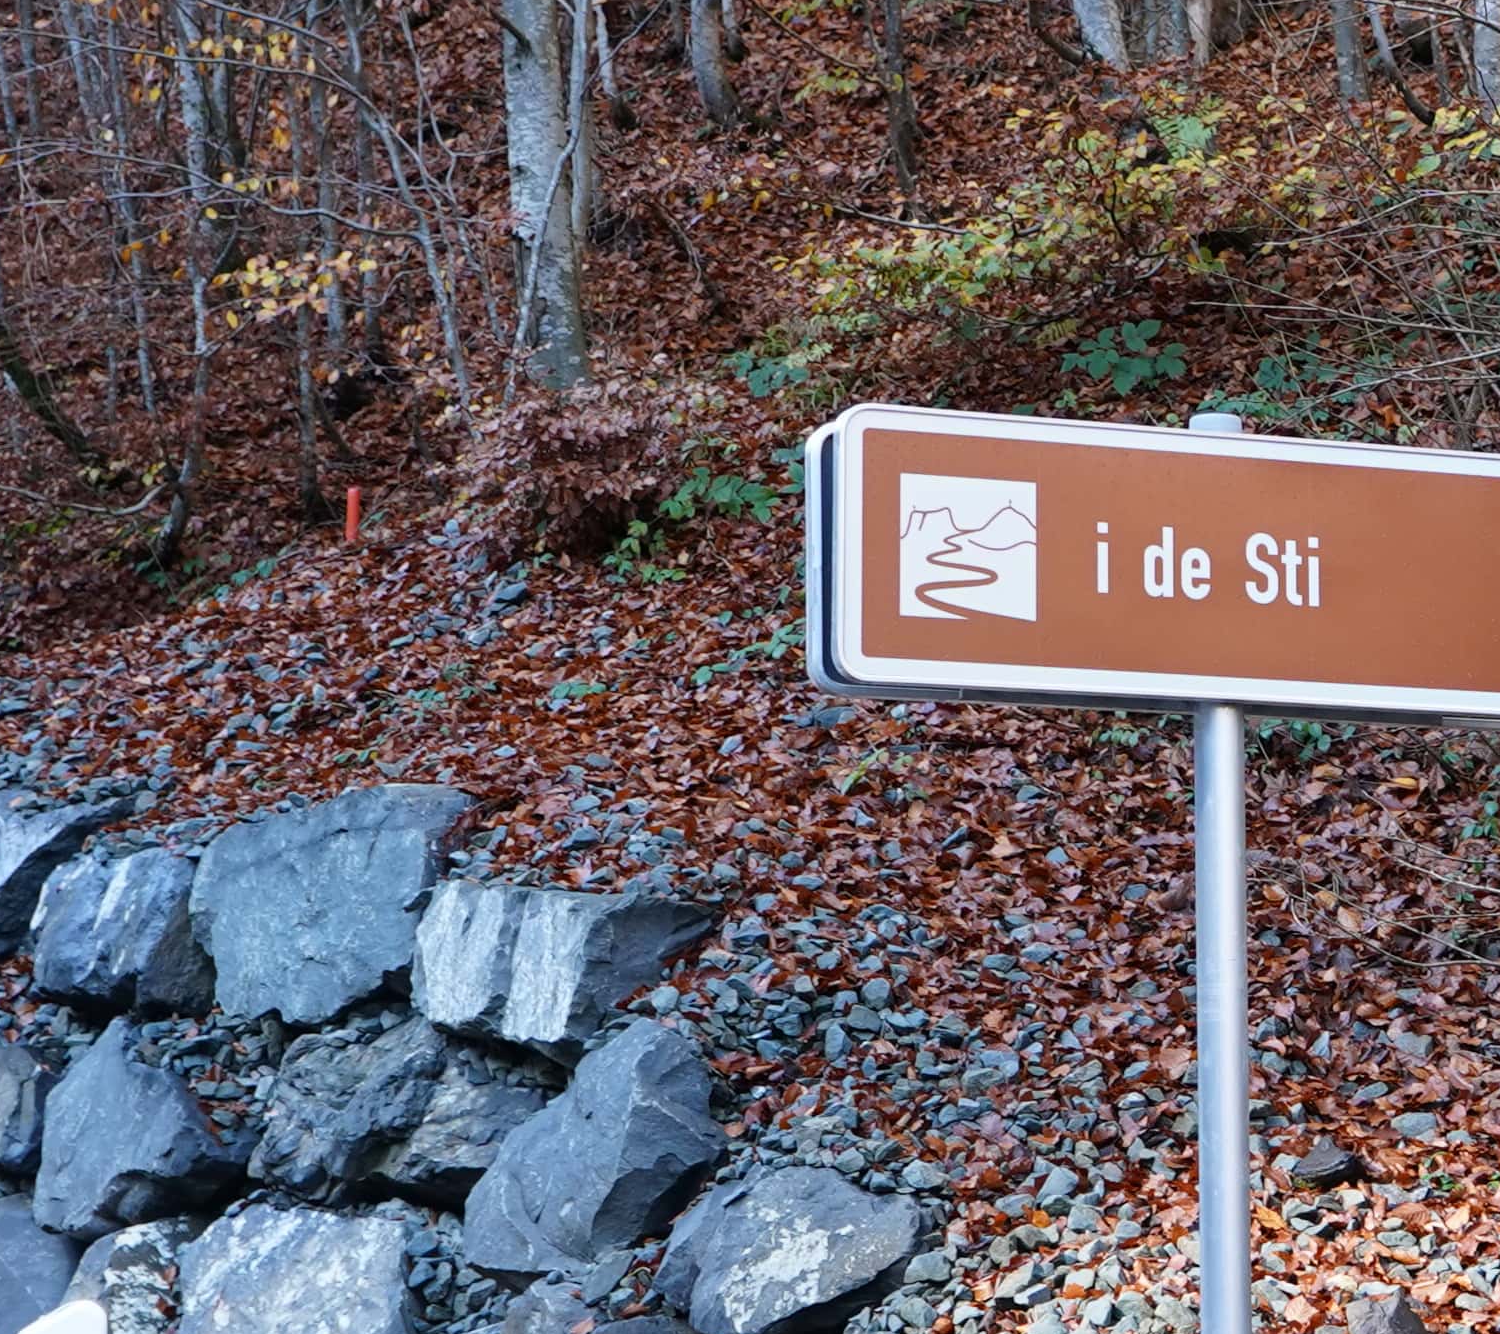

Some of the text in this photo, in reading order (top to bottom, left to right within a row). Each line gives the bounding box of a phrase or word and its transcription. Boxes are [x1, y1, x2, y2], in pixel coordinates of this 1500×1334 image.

[1095, 520, 1322, 609] i de Sti
